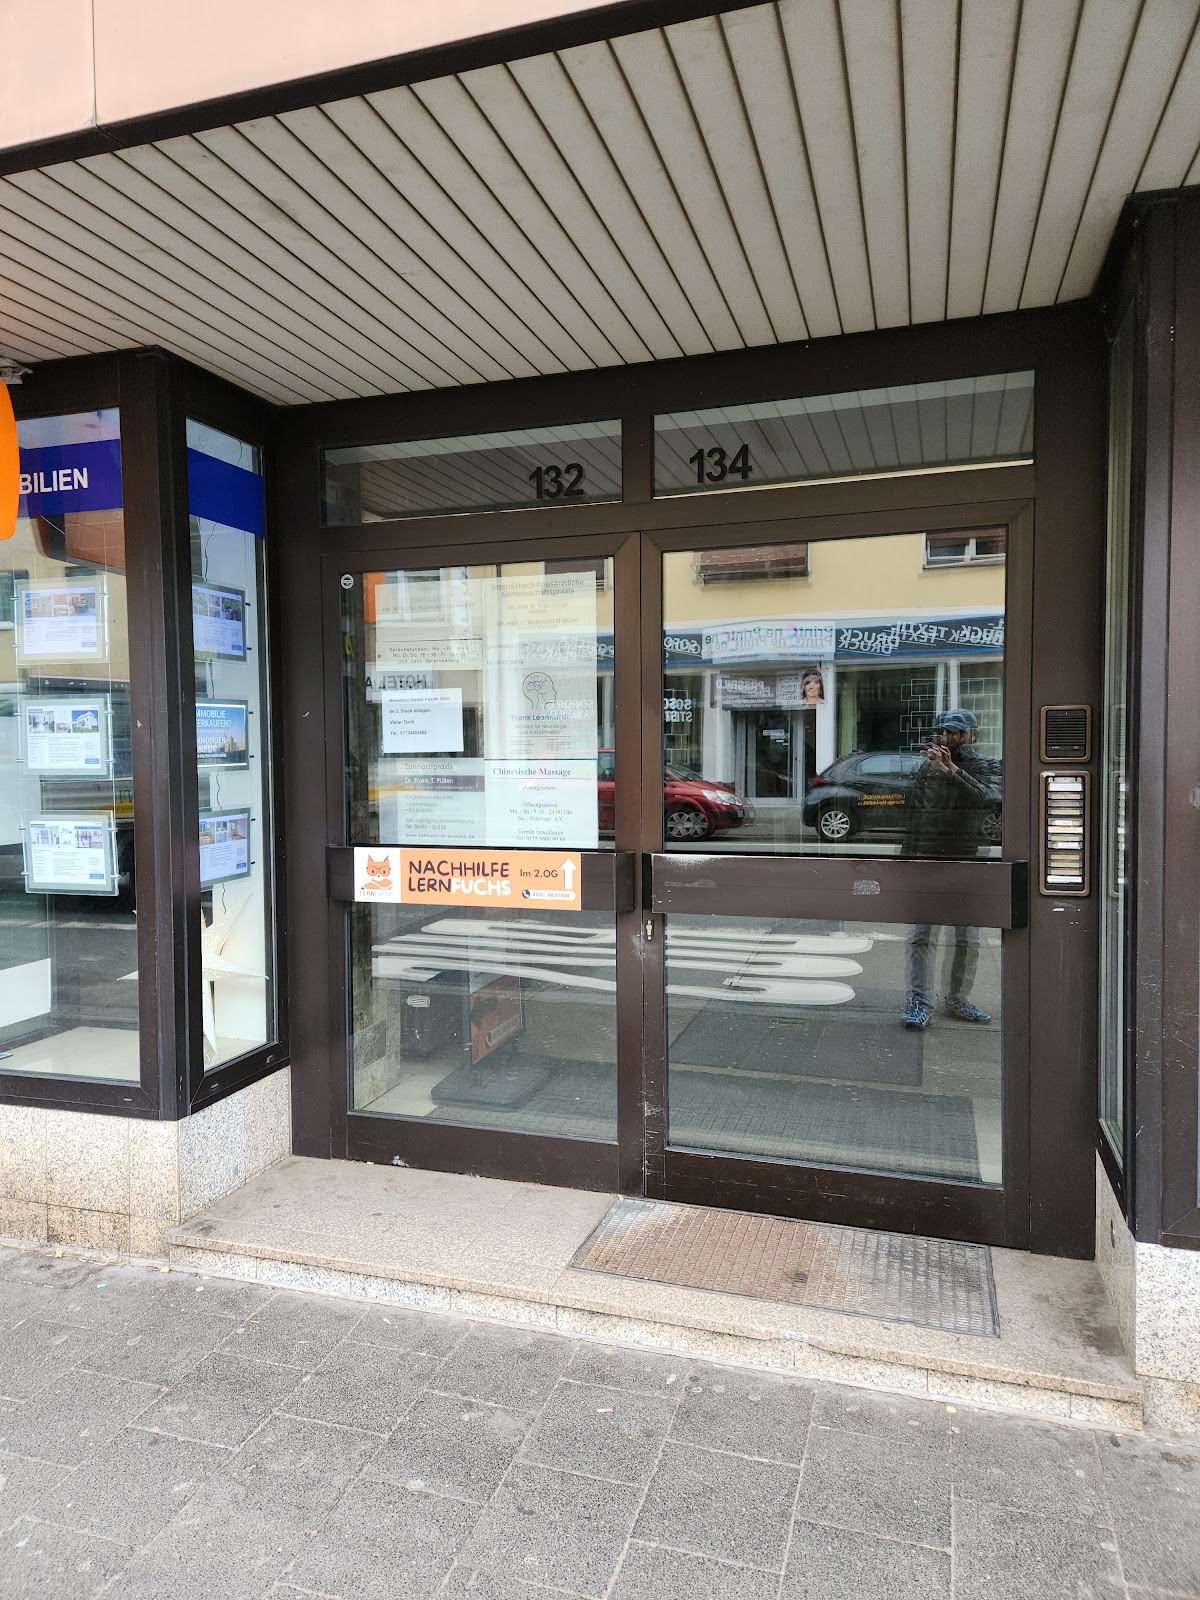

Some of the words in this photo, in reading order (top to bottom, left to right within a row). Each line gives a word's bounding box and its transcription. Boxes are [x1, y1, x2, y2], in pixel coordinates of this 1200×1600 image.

[689, 443, 754, 484] 134
[528, 462, 585, 500] 132
[501, 588, 575, 599] Gemeinschaftspraxis
[424, 657, 460, 665] Vereinbarung
[196, 719, 232, 728] ERKAUFEN?
[492, 767, 537, 776] Chinesische
[538, 768, 572, 778] Massage
[408, 860, 510, 879] NACHHILFE
[533, 869, 559, 879] 2.OG
[408, 876, 512, 897] LERNFUCHS
